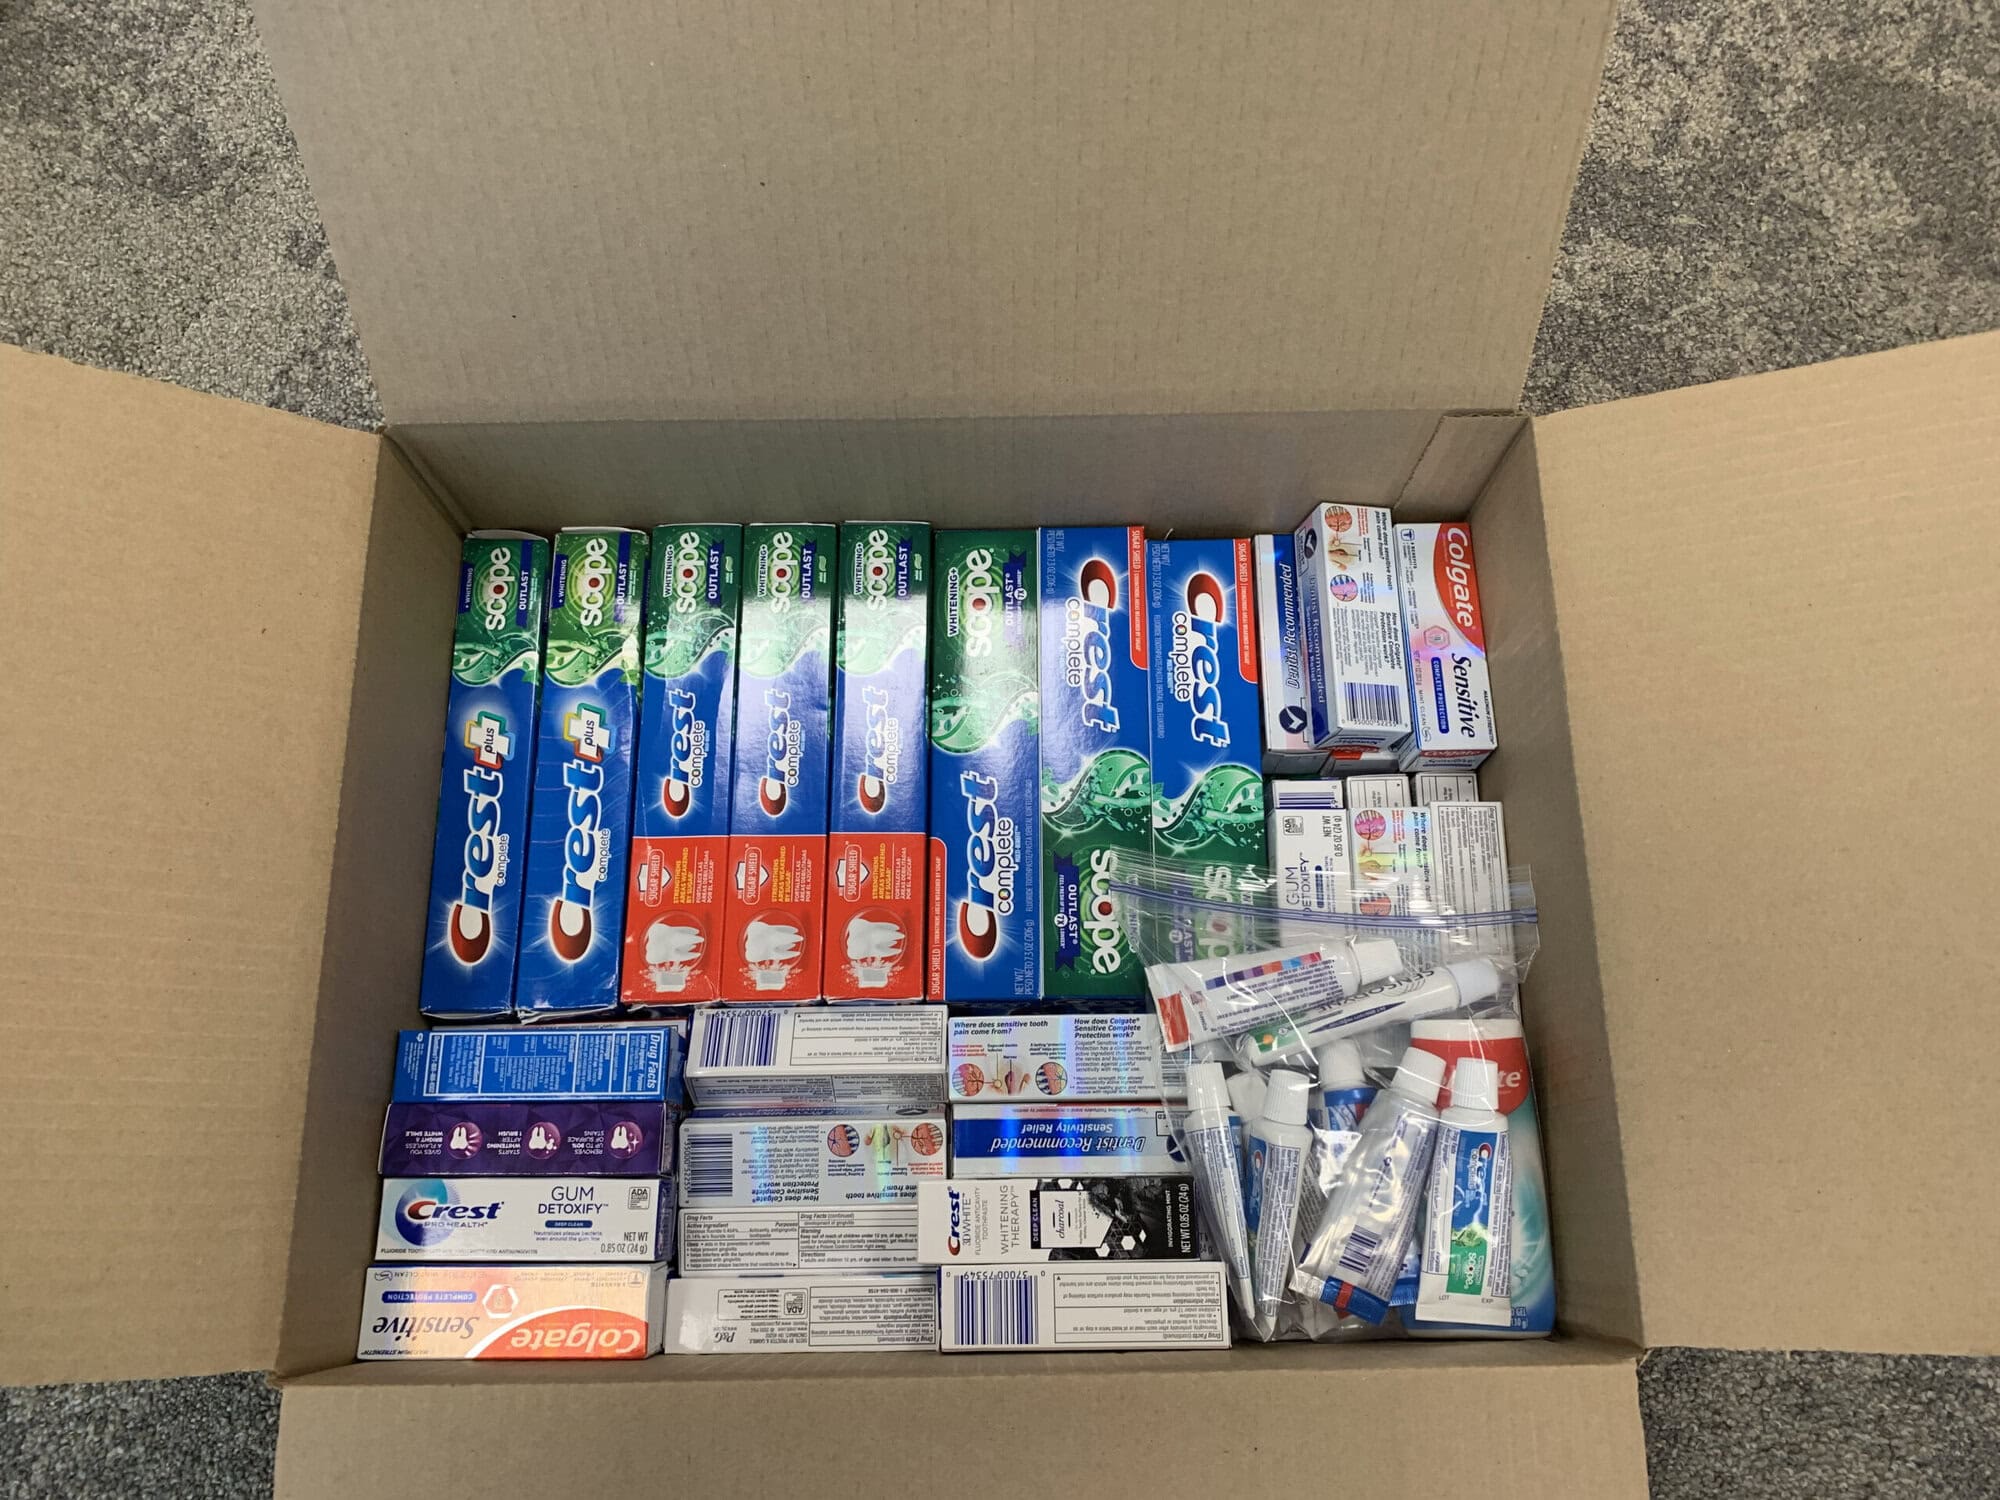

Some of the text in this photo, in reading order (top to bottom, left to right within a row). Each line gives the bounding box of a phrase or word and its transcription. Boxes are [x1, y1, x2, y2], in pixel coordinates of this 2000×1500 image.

[676, 532, 705, 613] scope
[770, 532, 799, 613] scope
[867, 530, 894, 611] scope
[898, 546, 909, 596] OUTLAST
[1132, 530, 1142, 569] SUGAR SHIELD
[1238, 543, 1249, 582] SUGAR SHIELD
[485, 547, 516, 631] scope
[519, 570, 529, 610] OUTLAST
[557, 560, 569, 598] WHITENING
[580, 538, 613, 627] scope
[617, 562, 628, 604] OUTLAST
[708, 549, 719, 599] OUTLAST
[801, 549, 812, 598] OUTLAST
[1446, 527, 1475, 627] Colgate
[948, 567, 960, 635] WHITENING+
[966, 549, 1000, 657] scope
[1063, 597, 1083, 687] complete
[1080, 559, 1120, 732] Crest
[1280, 564, 1300, 689] Dentist Recommended
[1169, 611, 1191, 701] complete
[1187, 572, 1231, 747] Crest
[1433, 660, 1447, 730] COMPLETE PROTECTION
[1451, 653, 1480, 738] Sensitive
[482, 727, 496, 755] plus
[583, 719, 597, 747] plus
[662, 689, 697, 818] Crest
[691, 721, 707, 786] complete
[759, 688, 790, 816] Crest
[786, 721, 803, 785] complete
[858, 686, 889, 815] Crest
[884, 719, 900, 784] complete
[1321, 816, 1329, 837] NET WT
[448, 767, 503, 966] Crest
[496, 833, 510, 886] complete
[548, 761, 604, 962] Crest
[598, 828, 612, 881] complete
[649, 854, 661, 901] SUGAR SHIELD
[747, 853, 758, 898] SUGAR SHIELD
[848, 850, 859, 896] SUGAR SHIELD
[957, 774, 998, 961] Crest
[997, 818, 1020, 916] complete
[1285, 866, 1300, 904] GUM
[1083, 849, 1120, 973] scope
[1024, 942, 1034, 951] OZ
[1024, 961, 1034, 978] NETO
[931, 948, 942, 995] SUGAR SHIELD
[1015, 983, 1024, 995] NET
[1024, 979, 1034, 995] PESO
[714, 1009, 773, 1018] 37000 75349
[953, 1021, 978, 1029] Where
[979, 1021, 996, 1029] does
[1029, 1020, 1049, 1028] tooth
[953, 1028, 969, 1037] pain
[990, 1027, 1013, 1036] from?
[1073, 1024, 1141, 1033] Sensitive Complete
[1073, 1031, 1134, 1039] Protection work?
[1074, 1018, 1088, 1026] How
[647, 1035, 660, 1088] Drug Facts
[990, 1136, 1146, 1153] Dentist Recommended
[1021, 1122, 1113, 1135] Sensitivity Relief
[551, 1186, 595, 1201] GUM
[751, 1187, 820, 1196] Sensitive Complete
[759, 1181, 820, 1189] Protection work?
[407, 1200, 504, 1220] Crest
[947, 1187, 961, 1257] Crest
[974, 1187, 983, 1256] FLUORIDE ANTICAVITY
[1000, 1185, 1009, 1255] WHITENING
[1031, 1197, 1040, 1242] DEEP CLEAN
[1053, 1200, 1066, 1240] charcoal
[1166, 1206, 1174, 1248] INVIGORATING
[1178, 1183, 1192, 1253] NET WT 0.85 OZ (24 g)
[600, 1243, 649, 1255] 0.85 OZ (24 g)
[623, 1232, 648, 1241] NET WT
[387, 1293, 433, 1301] PROTECTION
[963, 1270, 1028, 1280] 37000 75349
[372, 1316, 480, 1342] Sensitive
[512, 1322, 641, 1355] Colgate
[713, 1332, 736, 1343] P&G
